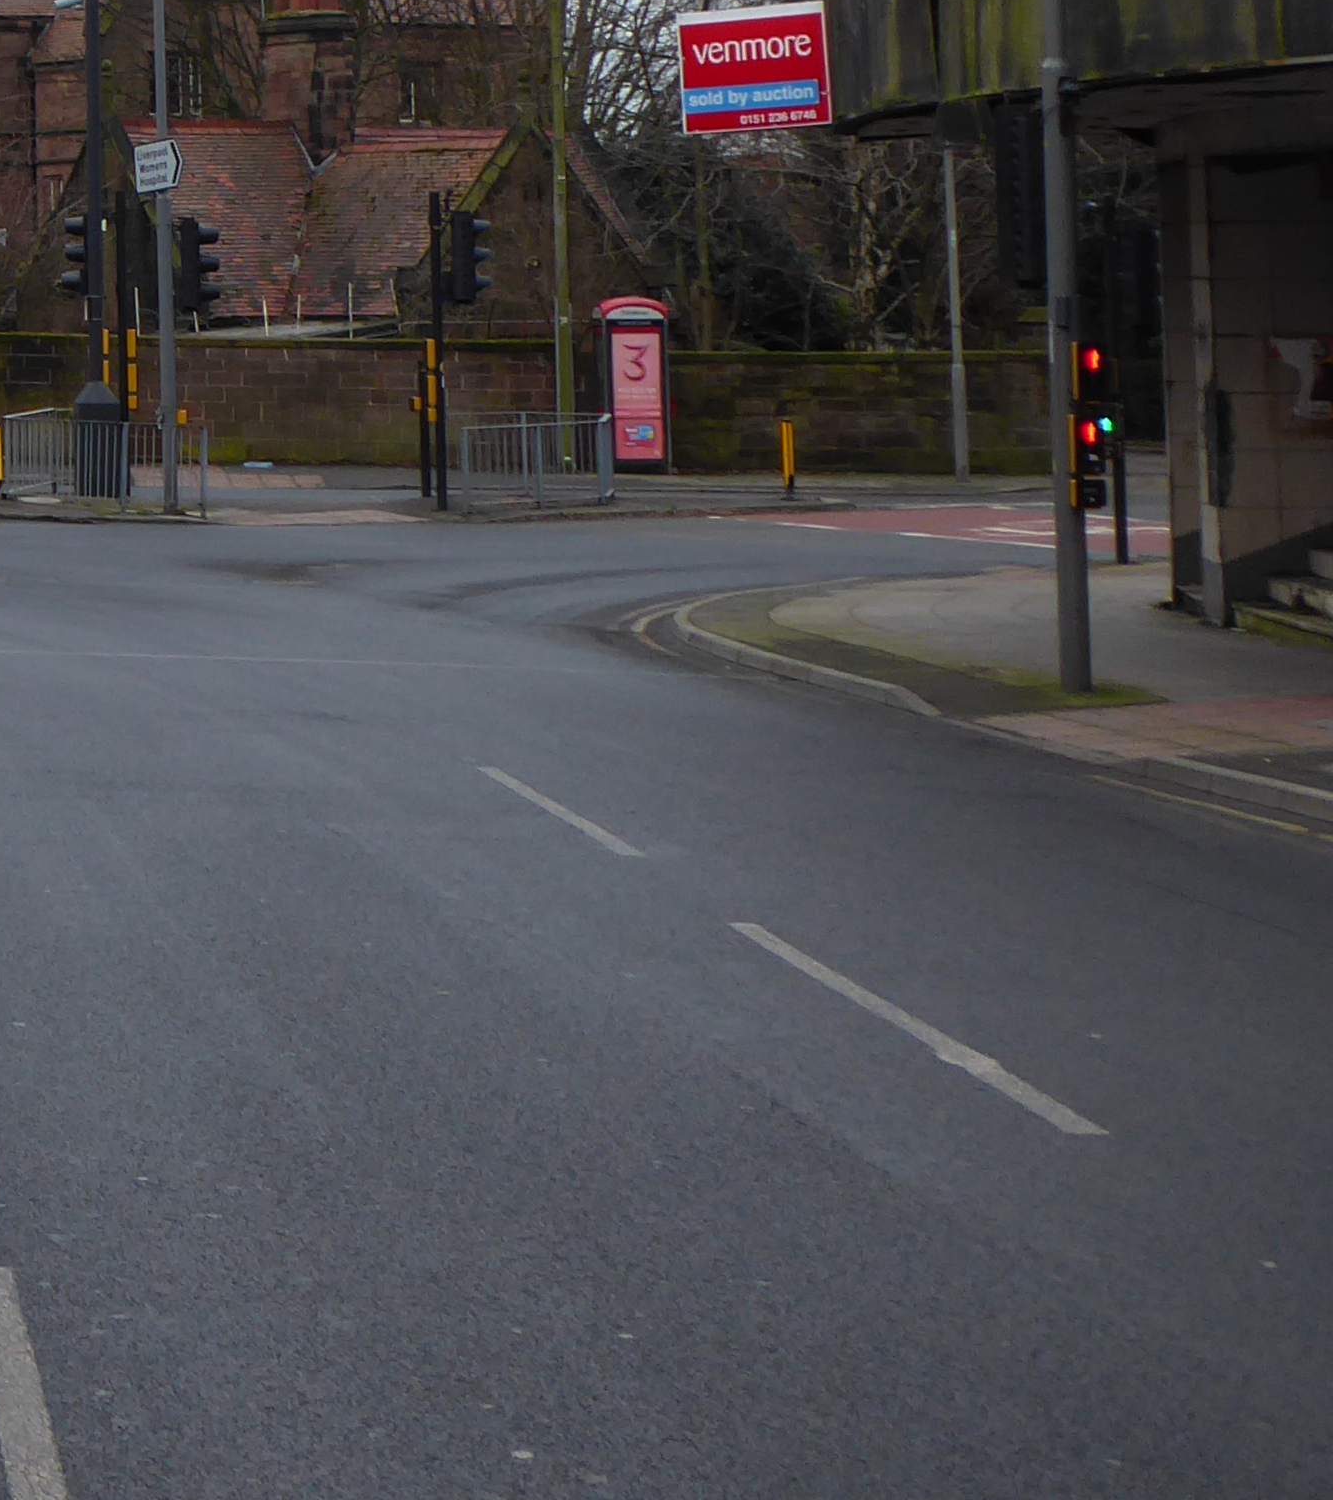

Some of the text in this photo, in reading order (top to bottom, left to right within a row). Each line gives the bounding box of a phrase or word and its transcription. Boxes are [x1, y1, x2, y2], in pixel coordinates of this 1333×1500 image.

[692, 34, 812, 65] venmore
[689, 85, 814, 107] sold by auction
[740, 113, 765, 125] 0151
[622, 344, 649, 381] 3
